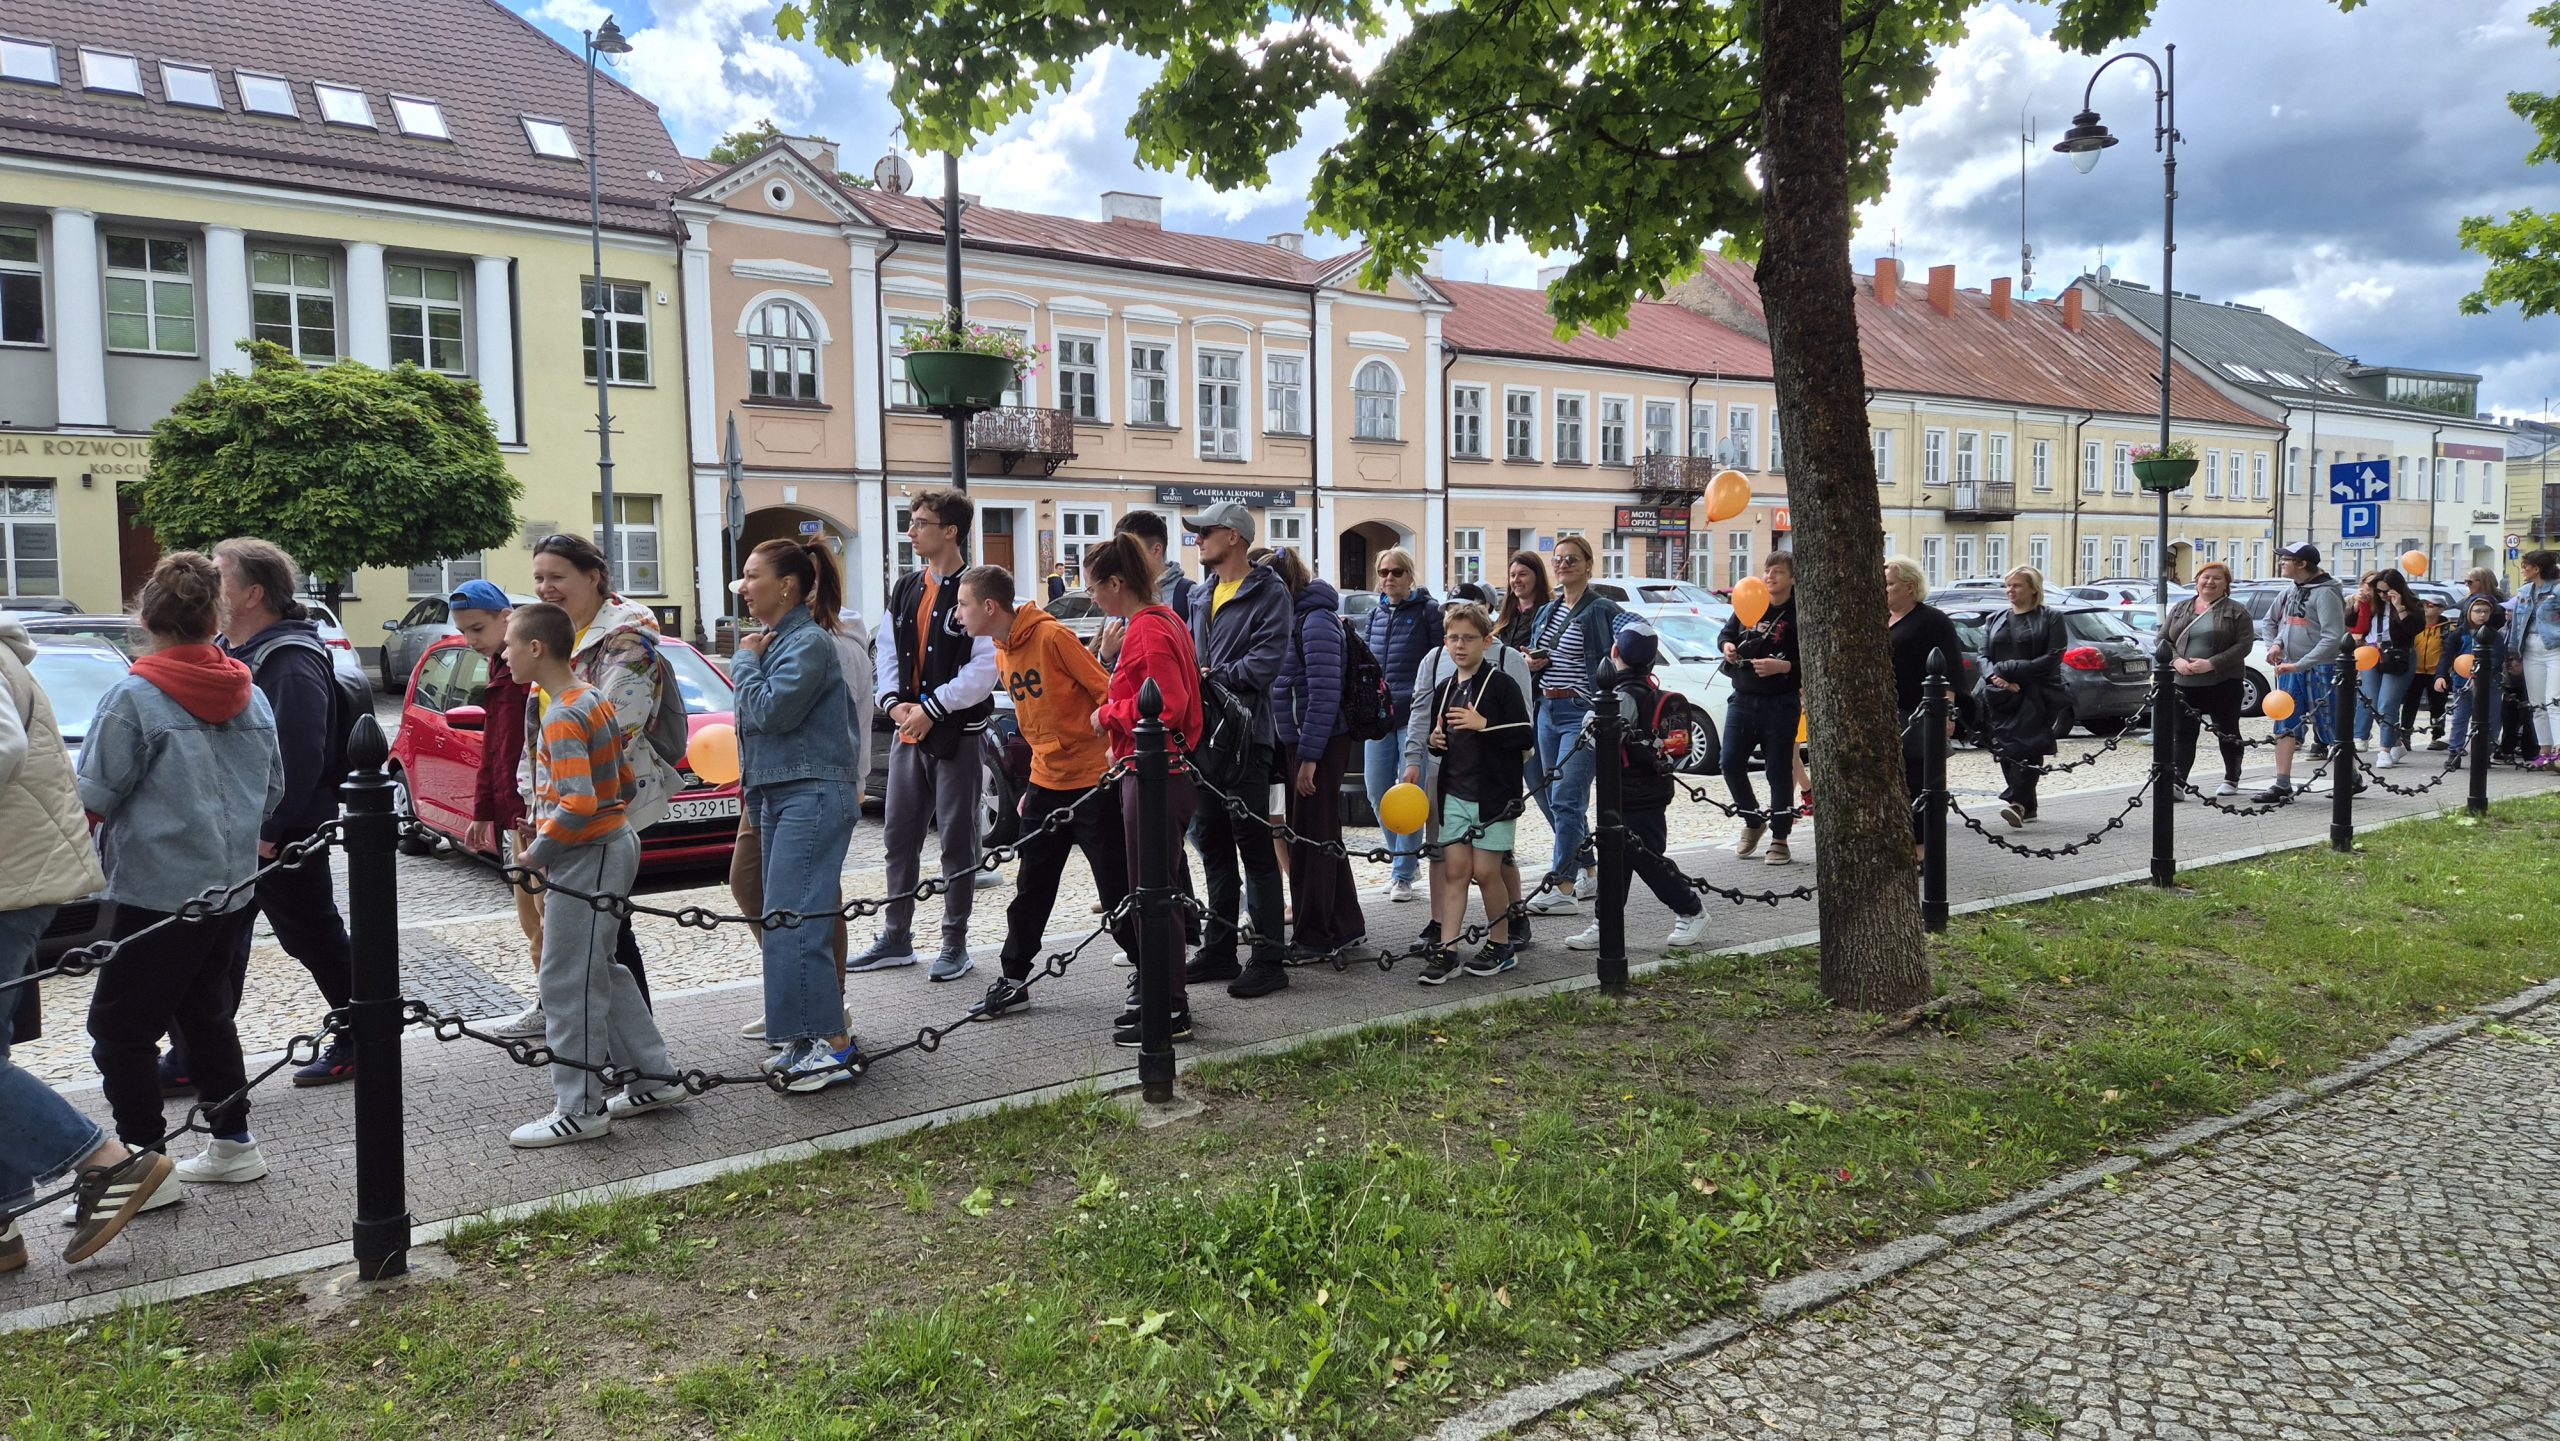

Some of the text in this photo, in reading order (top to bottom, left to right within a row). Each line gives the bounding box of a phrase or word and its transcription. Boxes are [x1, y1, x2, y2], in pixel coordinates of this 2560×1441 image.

[0, 439, 29, 456] JA
[1193, 488, 1264, 498] GALERIA ALKOHOLI
[1631, 511, 1657, 519] MOTYL
[1631, 519, 1657, 527] OFFICE
[2349, 507, 2369, 534] P
[1185, 536, 1195, 545] 60
[688, 799, 737, 818] 3291E
